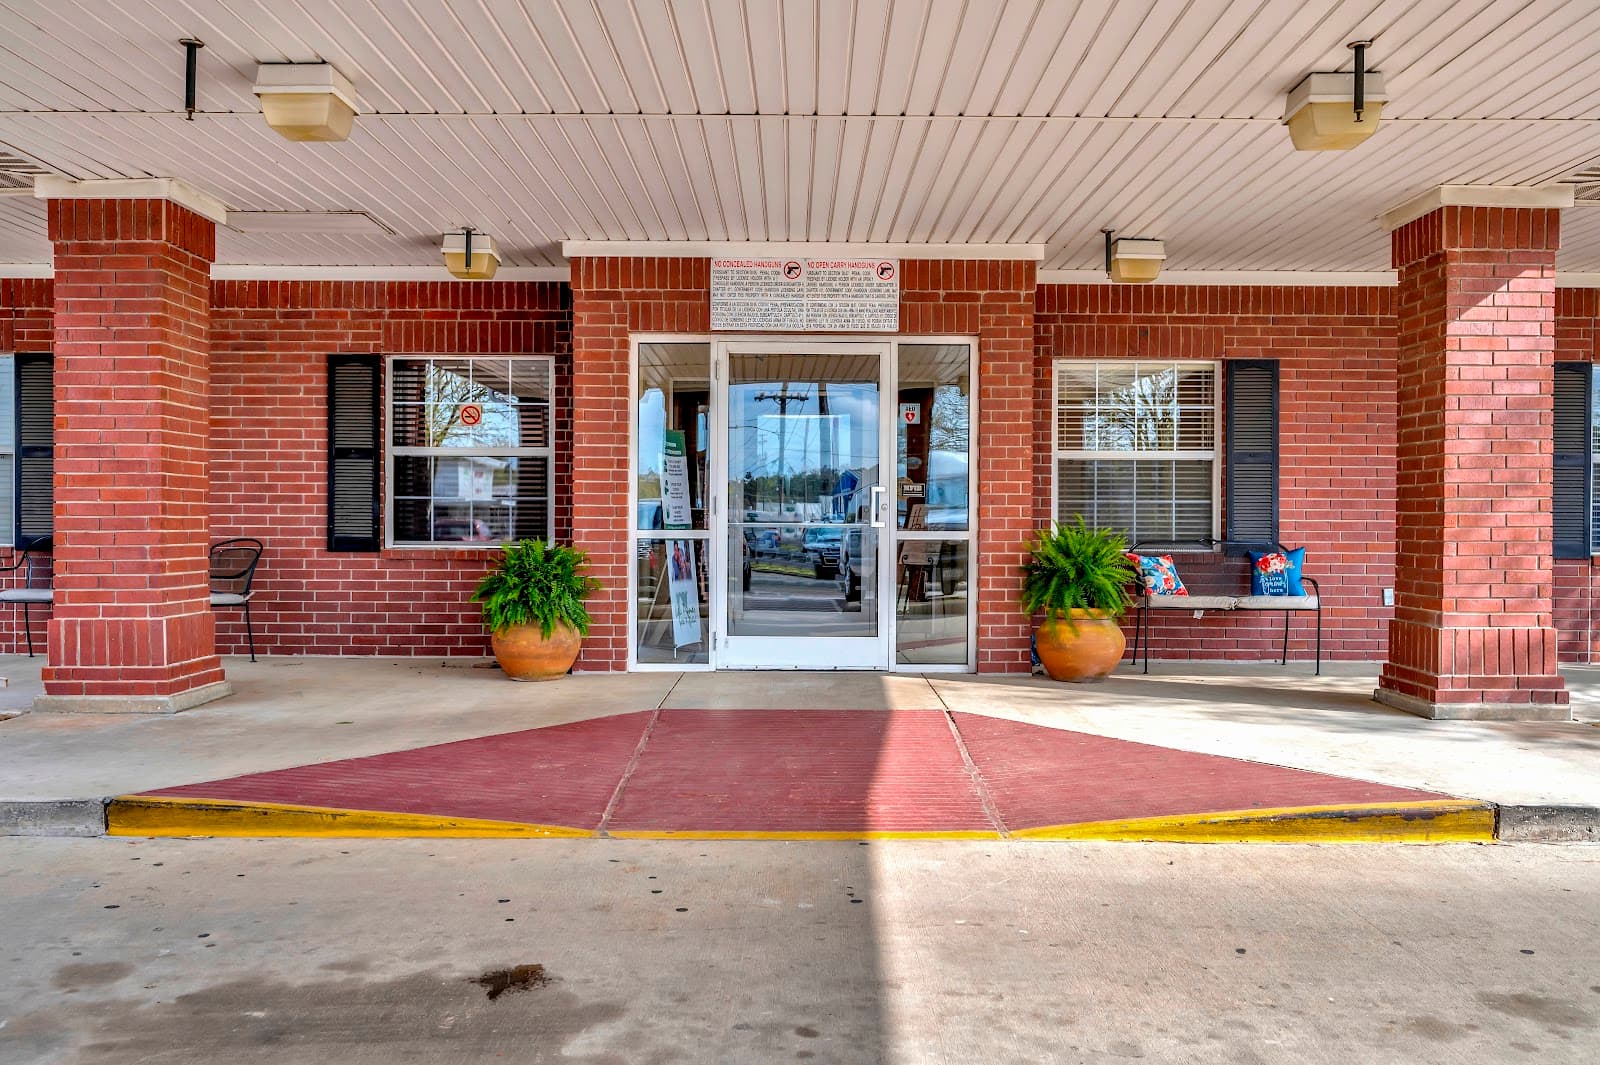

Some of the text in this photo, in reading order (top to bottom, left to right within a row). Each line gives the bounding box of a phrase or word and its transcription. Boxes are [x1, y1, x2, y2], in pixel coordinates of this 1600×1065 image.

[714, 260, 722, 268] NO
[723, 260, 753, 268] CONCEALED
[807, 261, 876, 269] NO OPEN CARRY HANDGUNS
